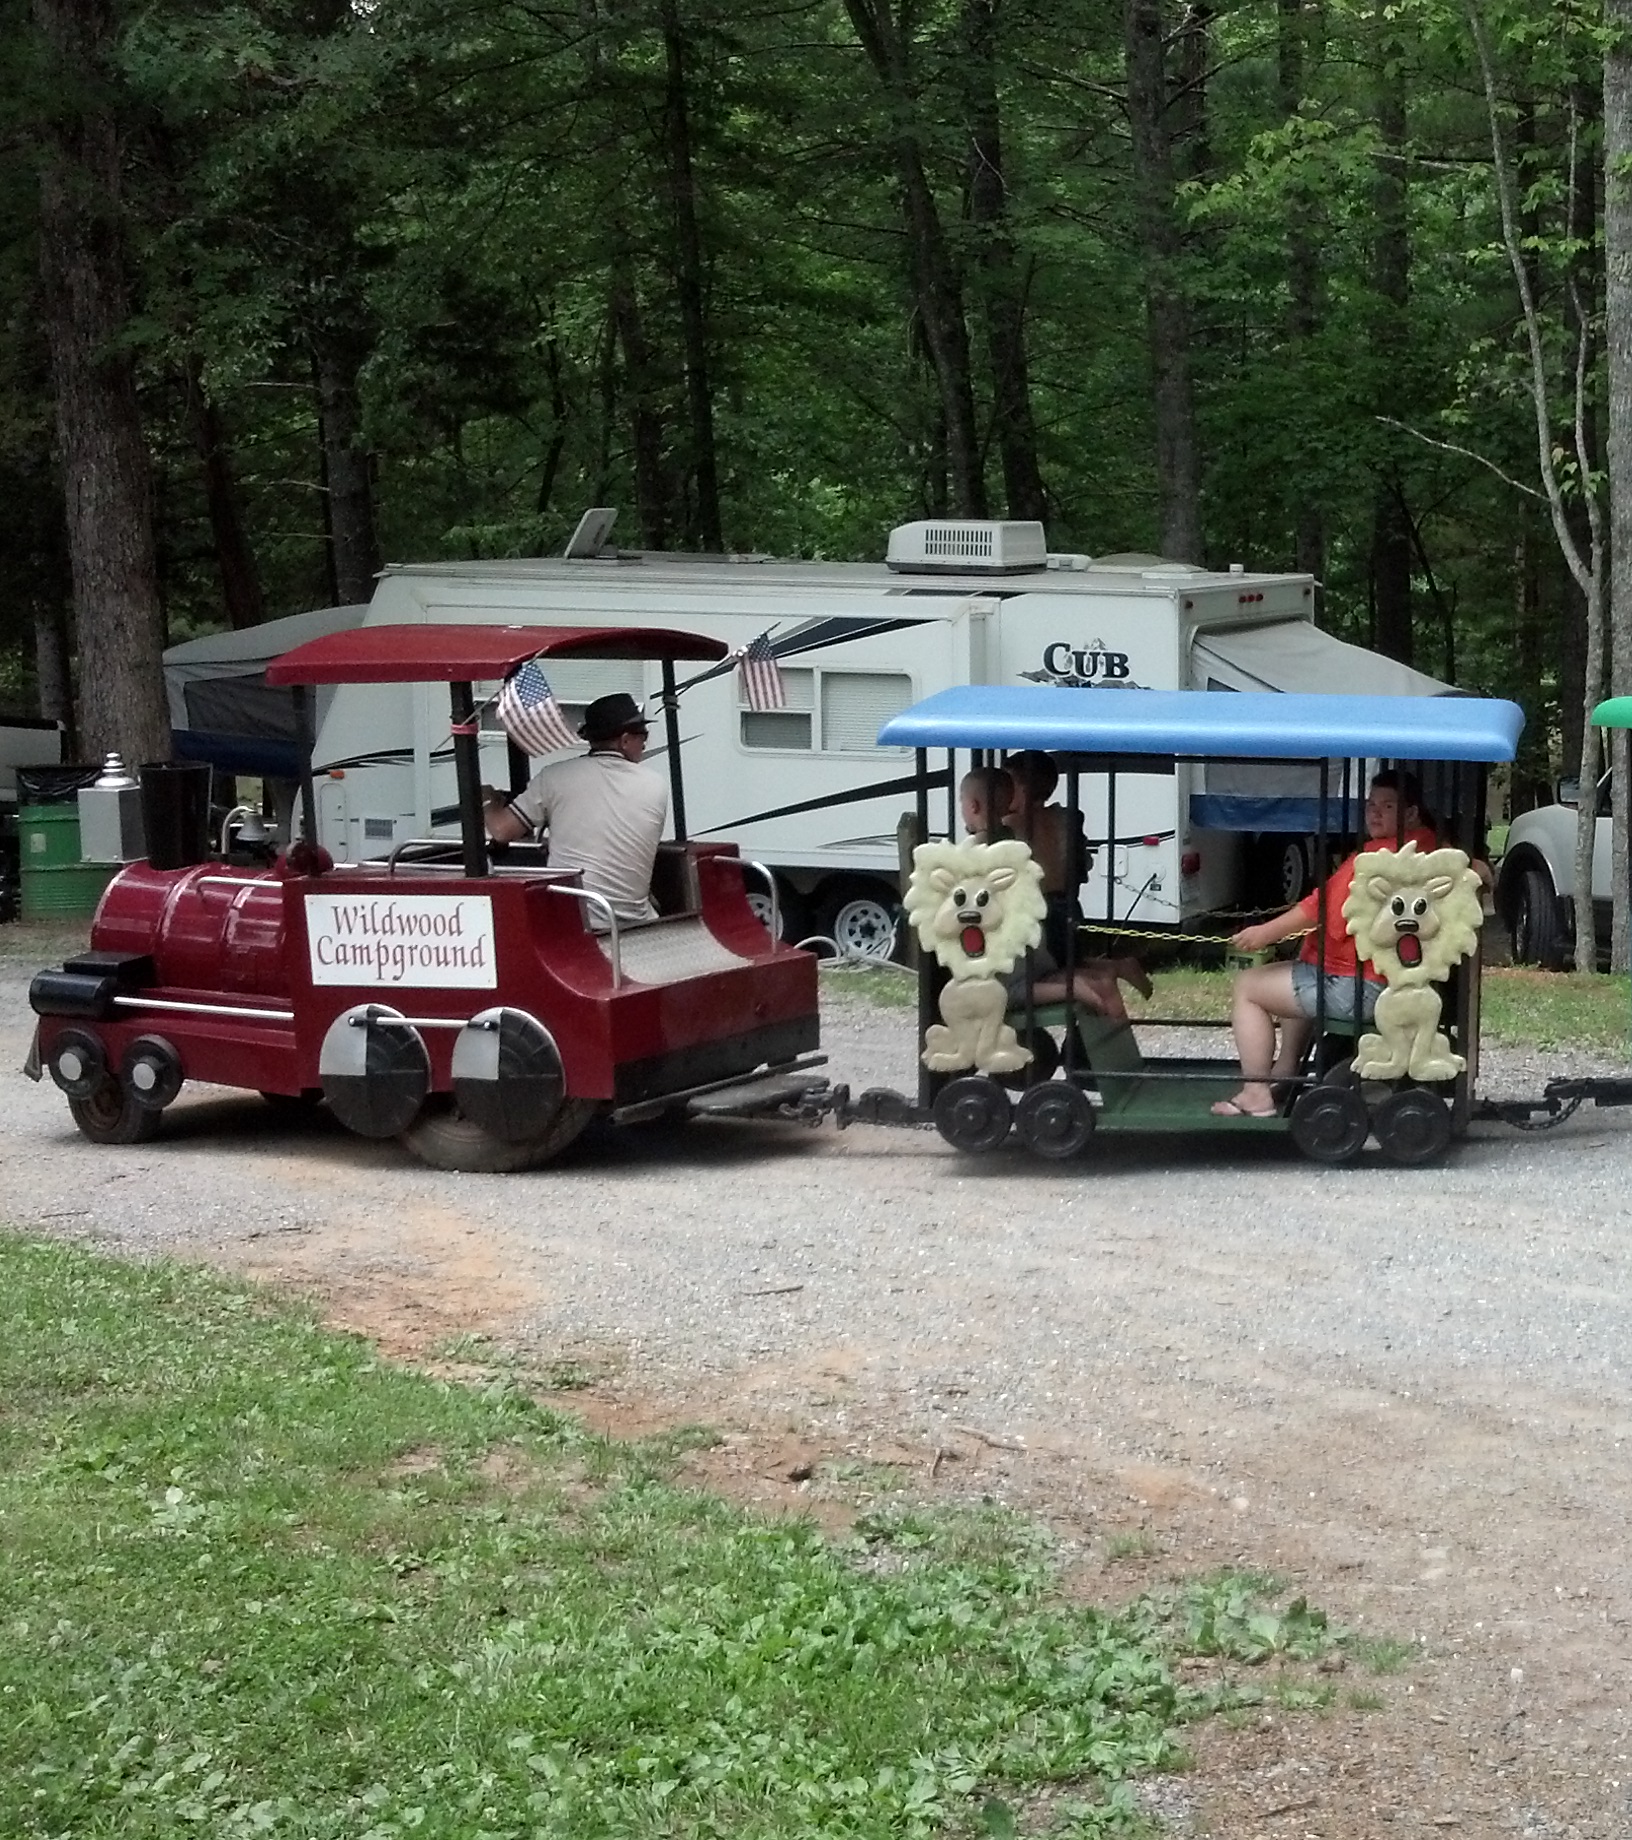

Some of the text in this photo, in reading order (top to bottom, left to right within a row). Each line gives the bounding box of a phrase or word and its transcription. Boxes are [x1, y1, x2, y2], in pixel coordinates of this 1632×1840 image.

[1043, 642, 1130, 679] CUB
[331, 902, 464, 937] Wildwood
[316, 934, 487, 981] Campground
